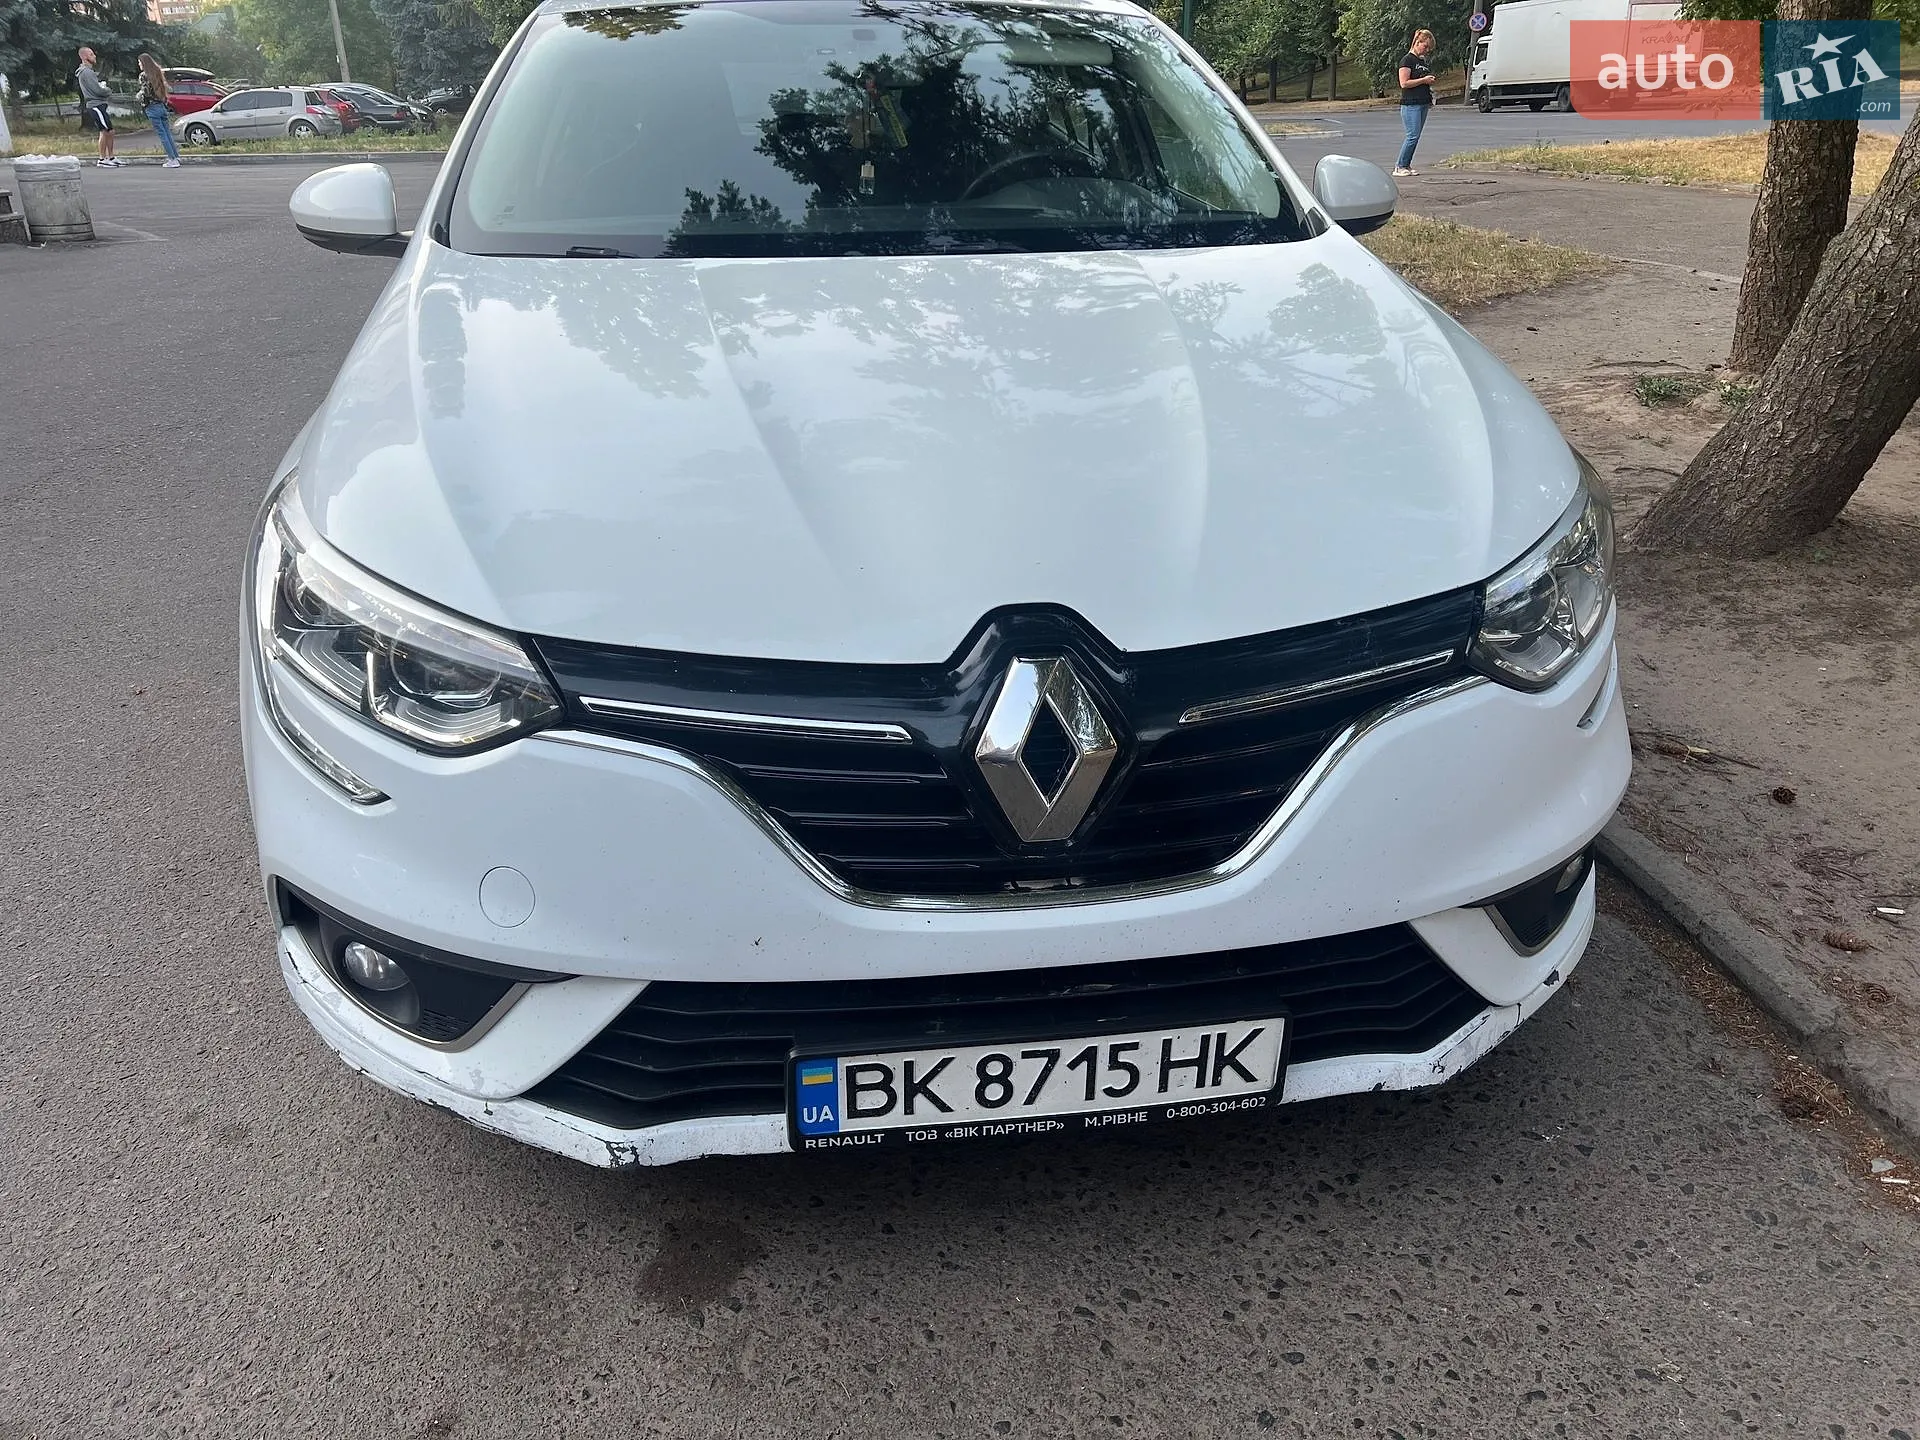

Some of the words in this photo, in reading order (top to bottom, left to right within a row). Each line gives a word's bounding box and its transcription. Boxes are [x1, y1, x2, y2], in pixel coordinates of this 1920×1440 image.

[845, 1056, 956, 1119] BK
[974, 1040, 1140, 1109] 8715
[802, 1105, 834, 1124] UA
[805, 1133, 885, 1149] RENAULT
[906, 1130, 938, 1142] ТОВ
[982, 1119, 1065, 1136] ПАРТНЕР»
[1166, 1096, 1267, 1119] 0-800-304-602
